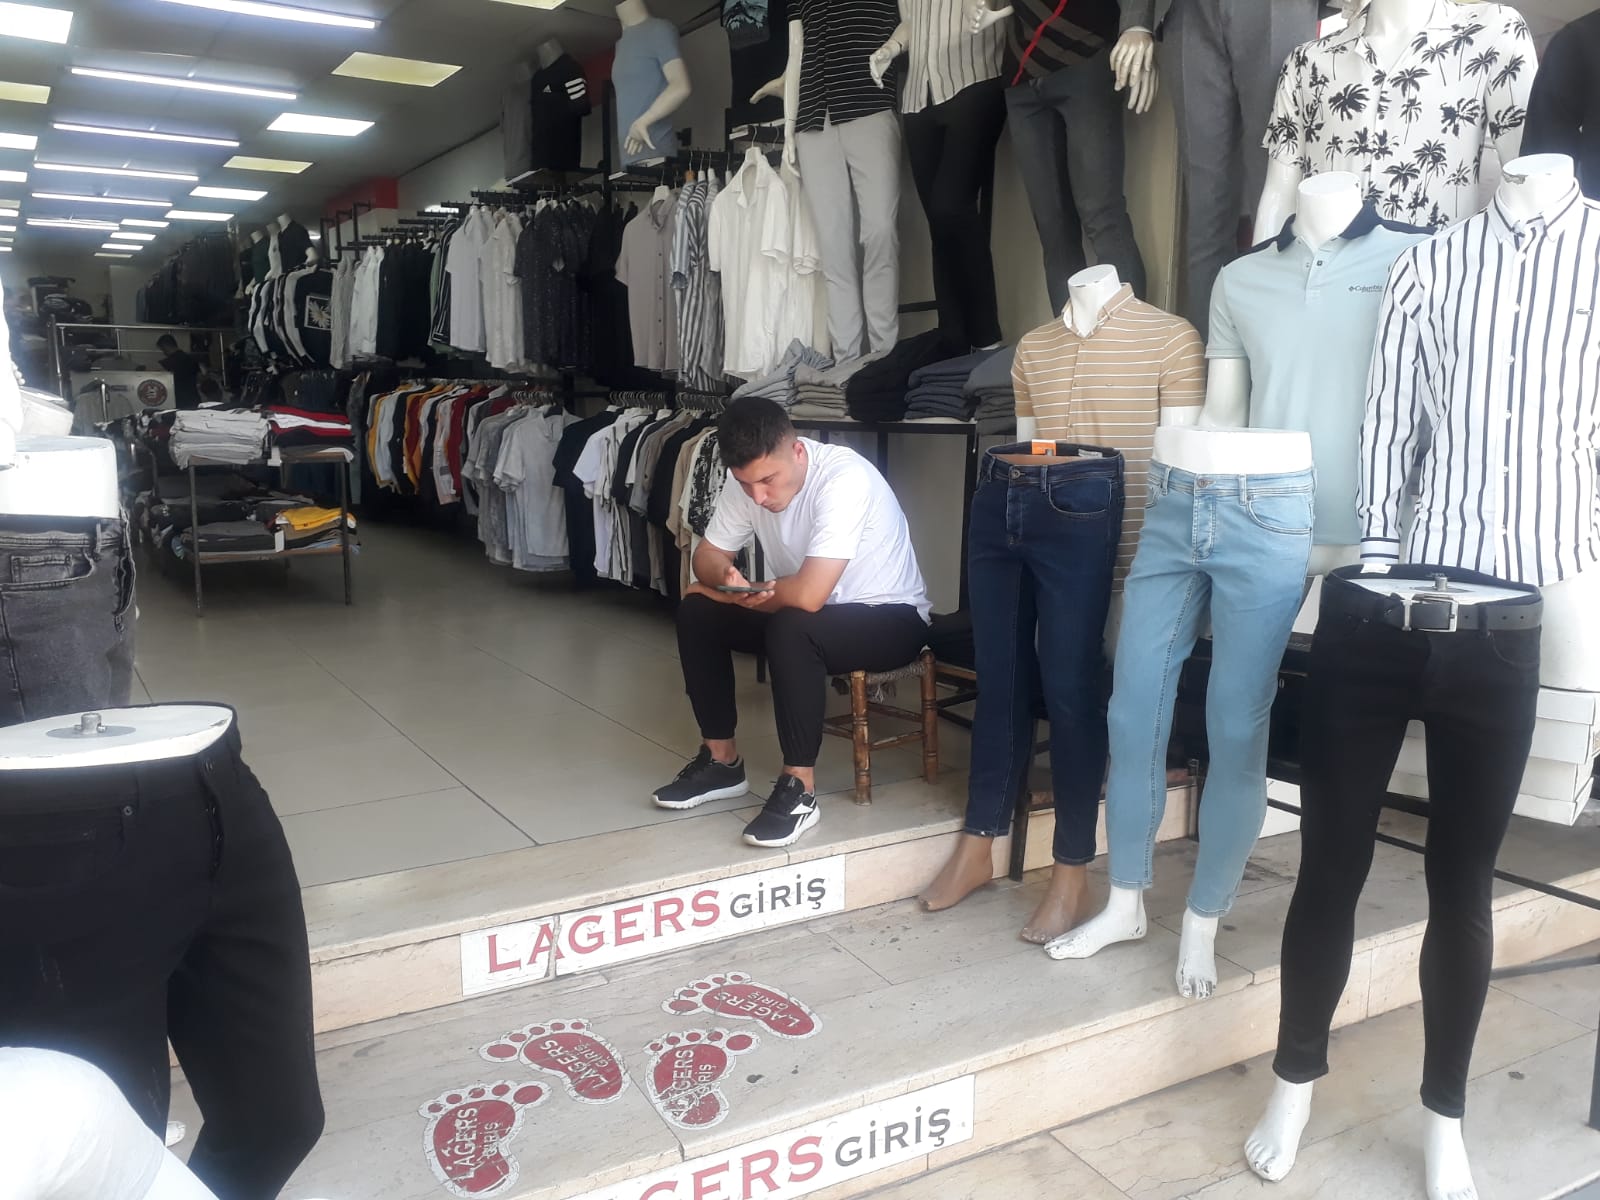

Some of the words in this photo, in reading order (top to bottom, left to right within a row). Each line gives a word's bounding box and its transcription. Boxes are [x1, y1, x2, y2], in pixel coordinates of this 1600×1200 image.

[487, 889, 721, 974] LAGERS
[729, 873, 826, 920] GİRİŞ
[714, 991, 801, 1028] LAGERS
[540, 1040, 609, 1089] LAGERS
[834, 1105, 951, 1168] GİRİŞ
